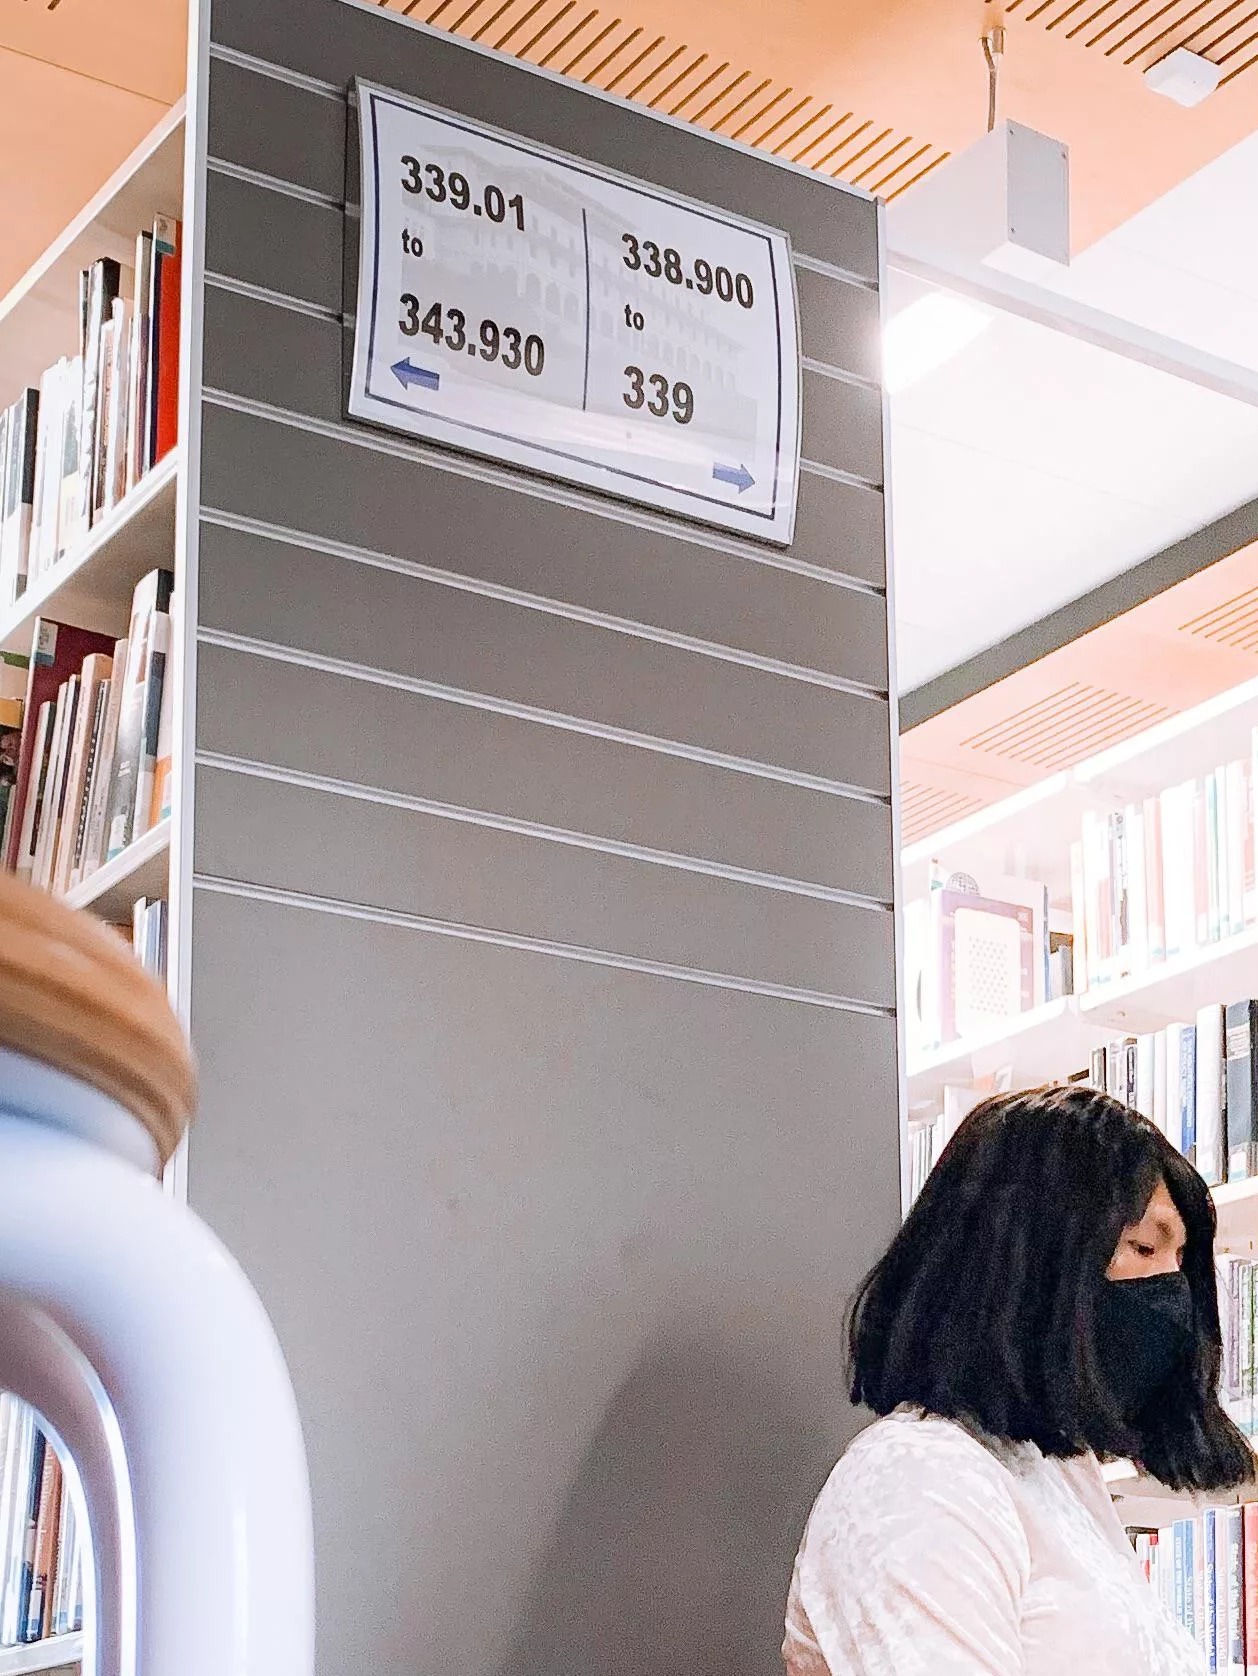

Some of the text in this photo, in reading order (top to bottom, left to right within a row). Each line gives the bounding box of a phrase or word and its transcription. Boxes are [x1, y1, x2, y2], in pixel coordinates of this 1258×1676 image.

[400, 155, 526, 231] 339.01
[402, 228, 423, 258] to
[622, 233, 754, 309] 338.900
[399, 293, 545, 376] 343.930
[624, 304, 645, 331] to
[622, 366, 694, 424] 339
